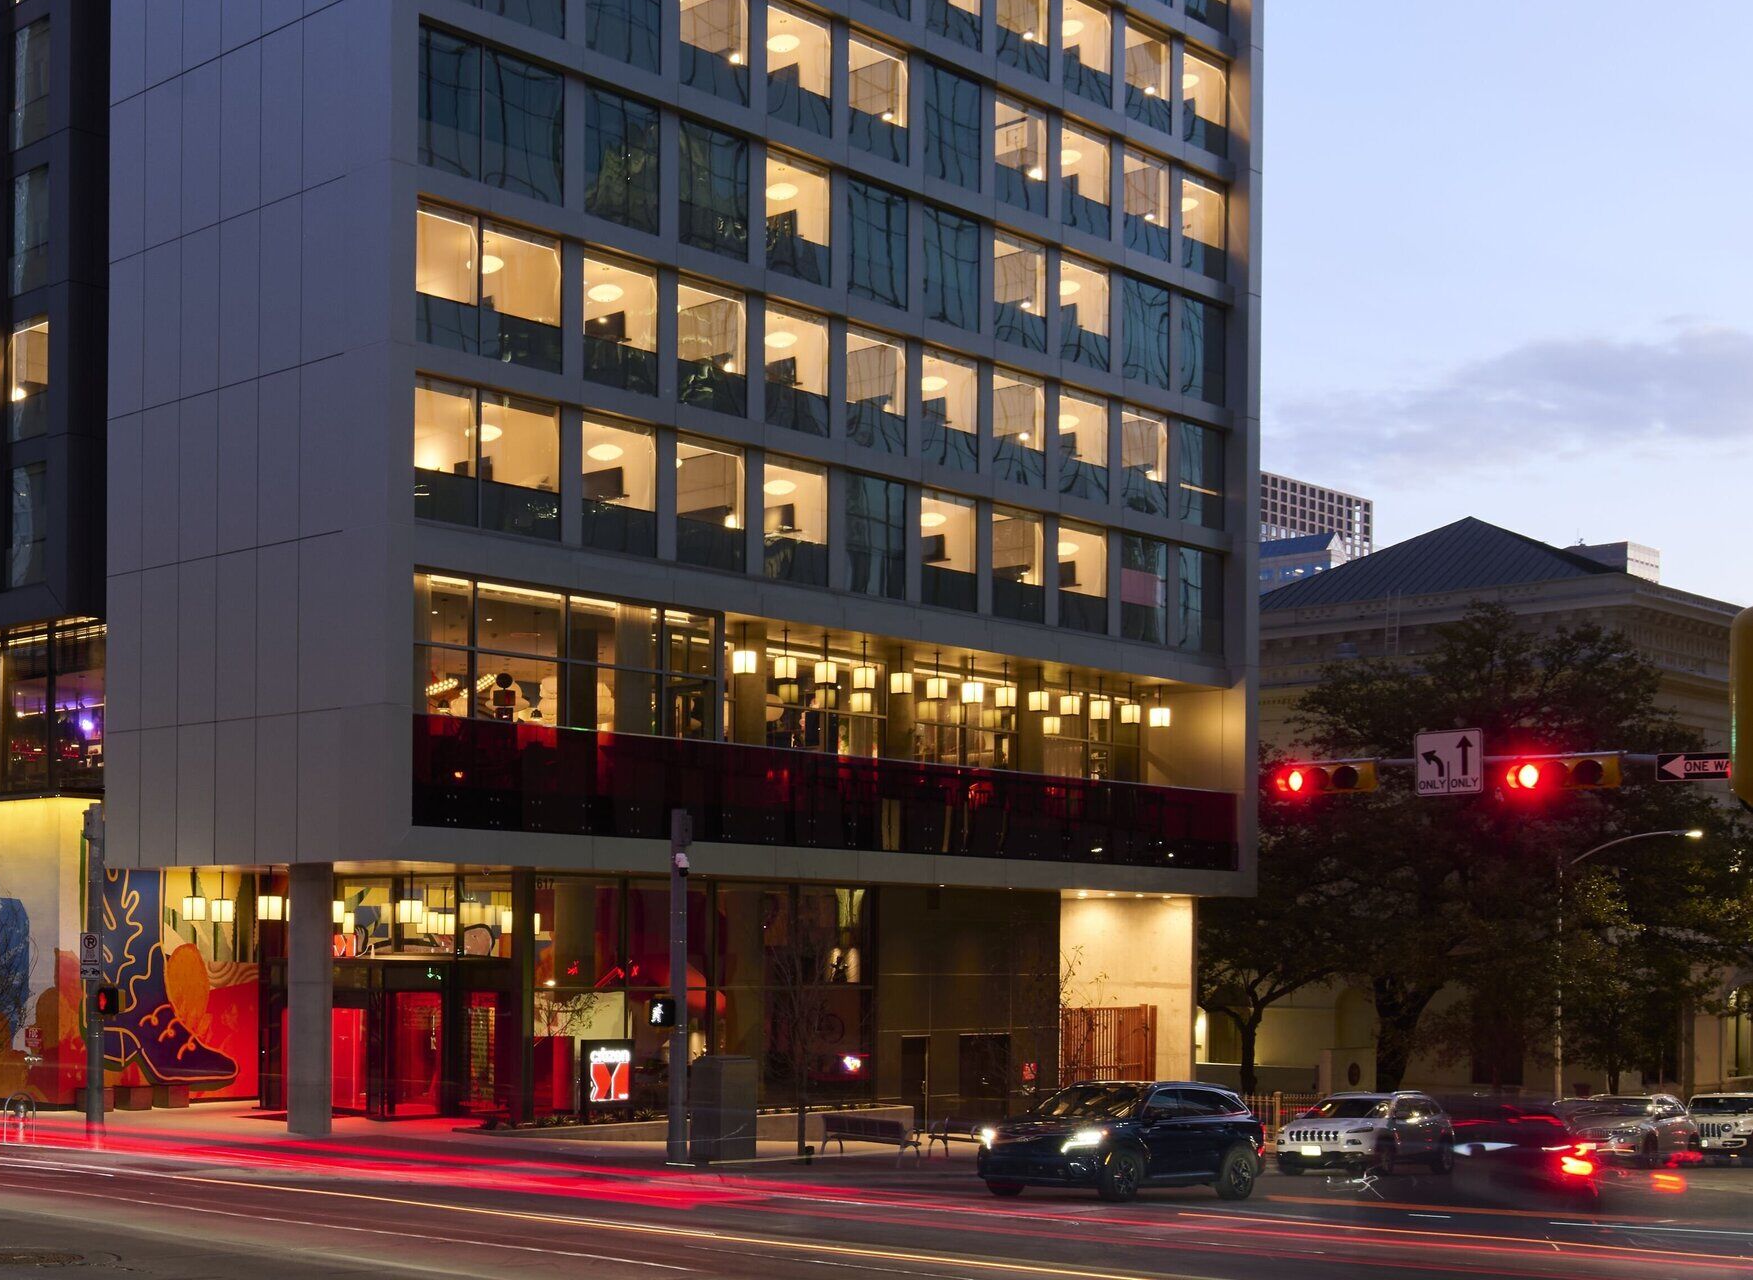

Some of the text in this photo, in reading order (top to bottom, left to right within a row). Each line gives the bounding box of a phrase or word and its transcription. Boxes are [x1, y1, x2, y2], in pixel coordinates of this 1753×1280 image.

[1684, 759, 1731, 772] ONE WA
[1418, 780, 1447, 790] ONLY
[1450, 777, 1479, 788] ONLY
